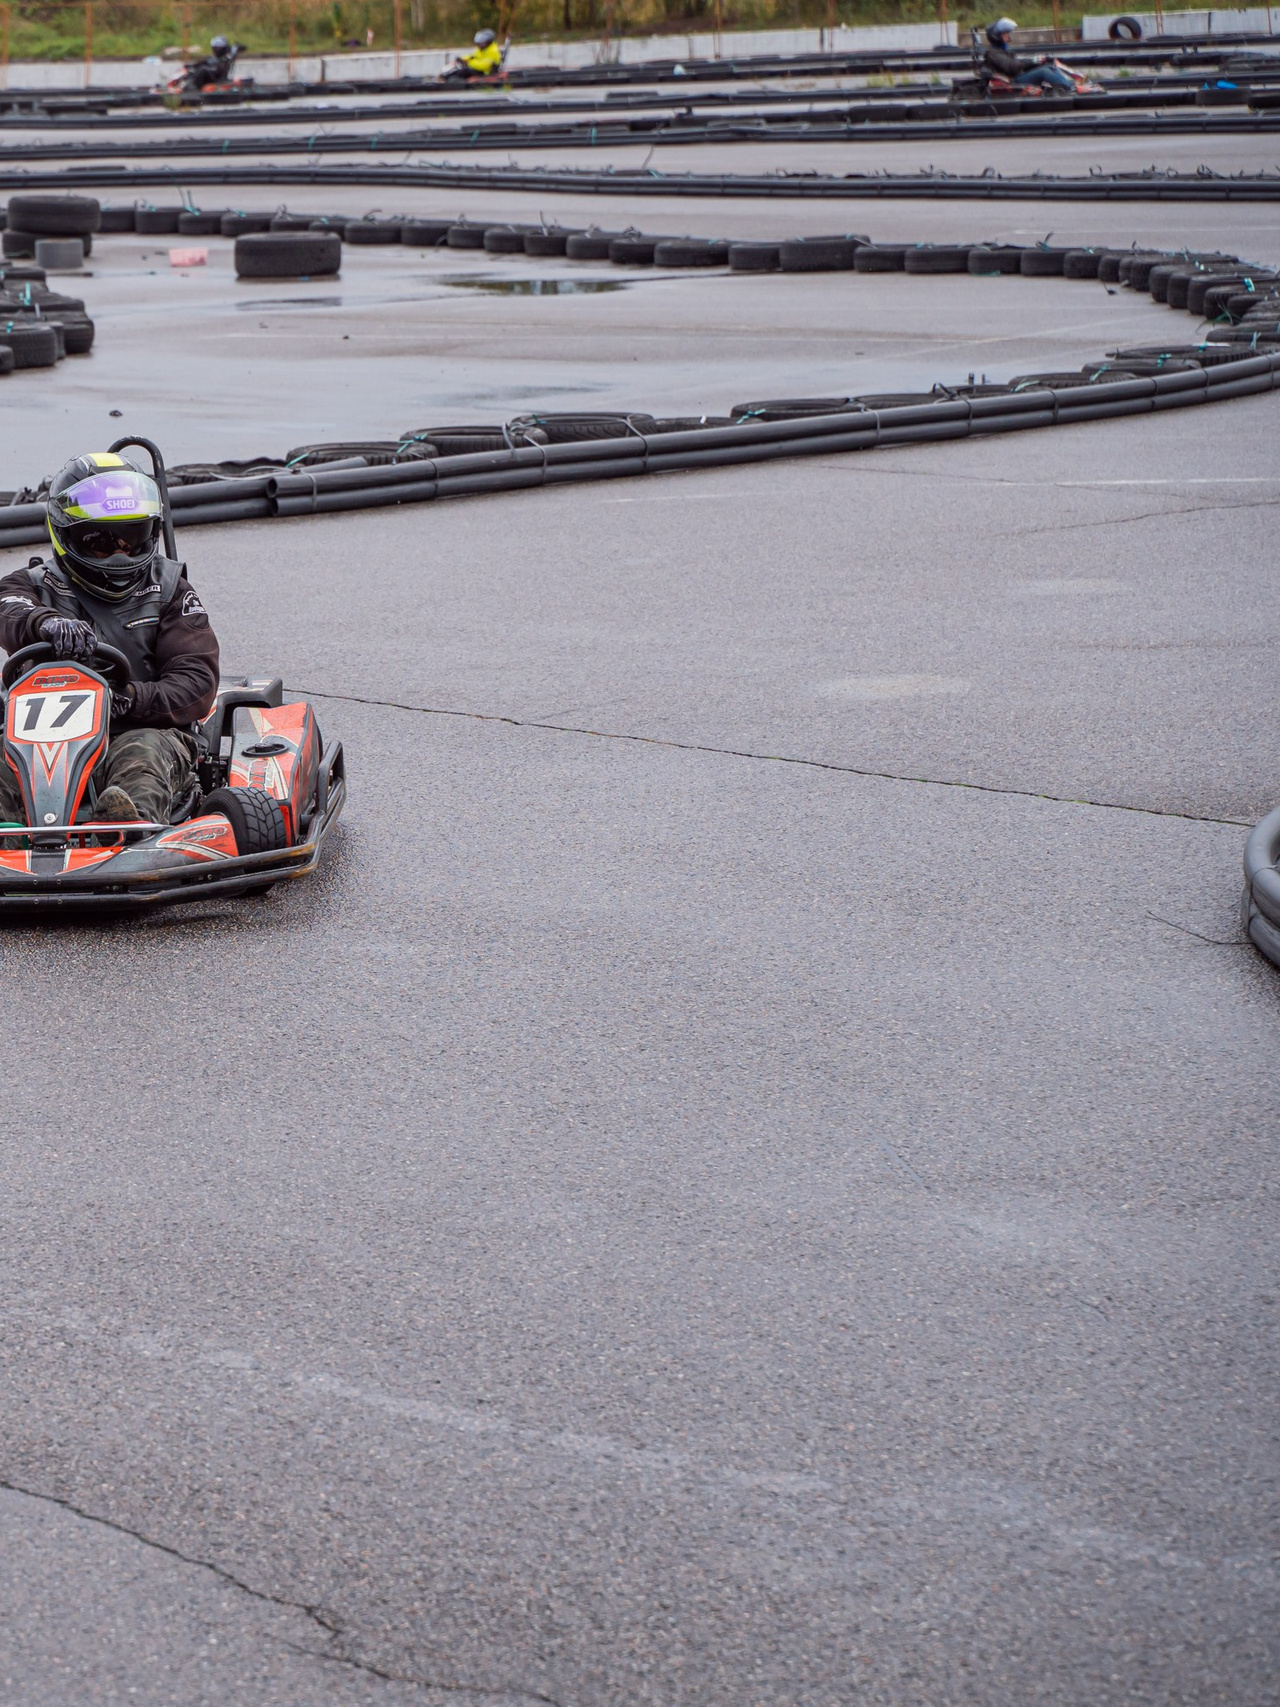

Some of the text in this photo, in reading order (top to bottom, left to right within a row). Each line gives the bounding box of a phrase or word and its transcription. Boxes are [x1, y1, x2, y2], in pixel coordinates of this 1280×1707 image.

[106, 500, 135, 510] SHOEI
[33, 675, 79, 685] DINO
[23, 694, 91, 731] 17
